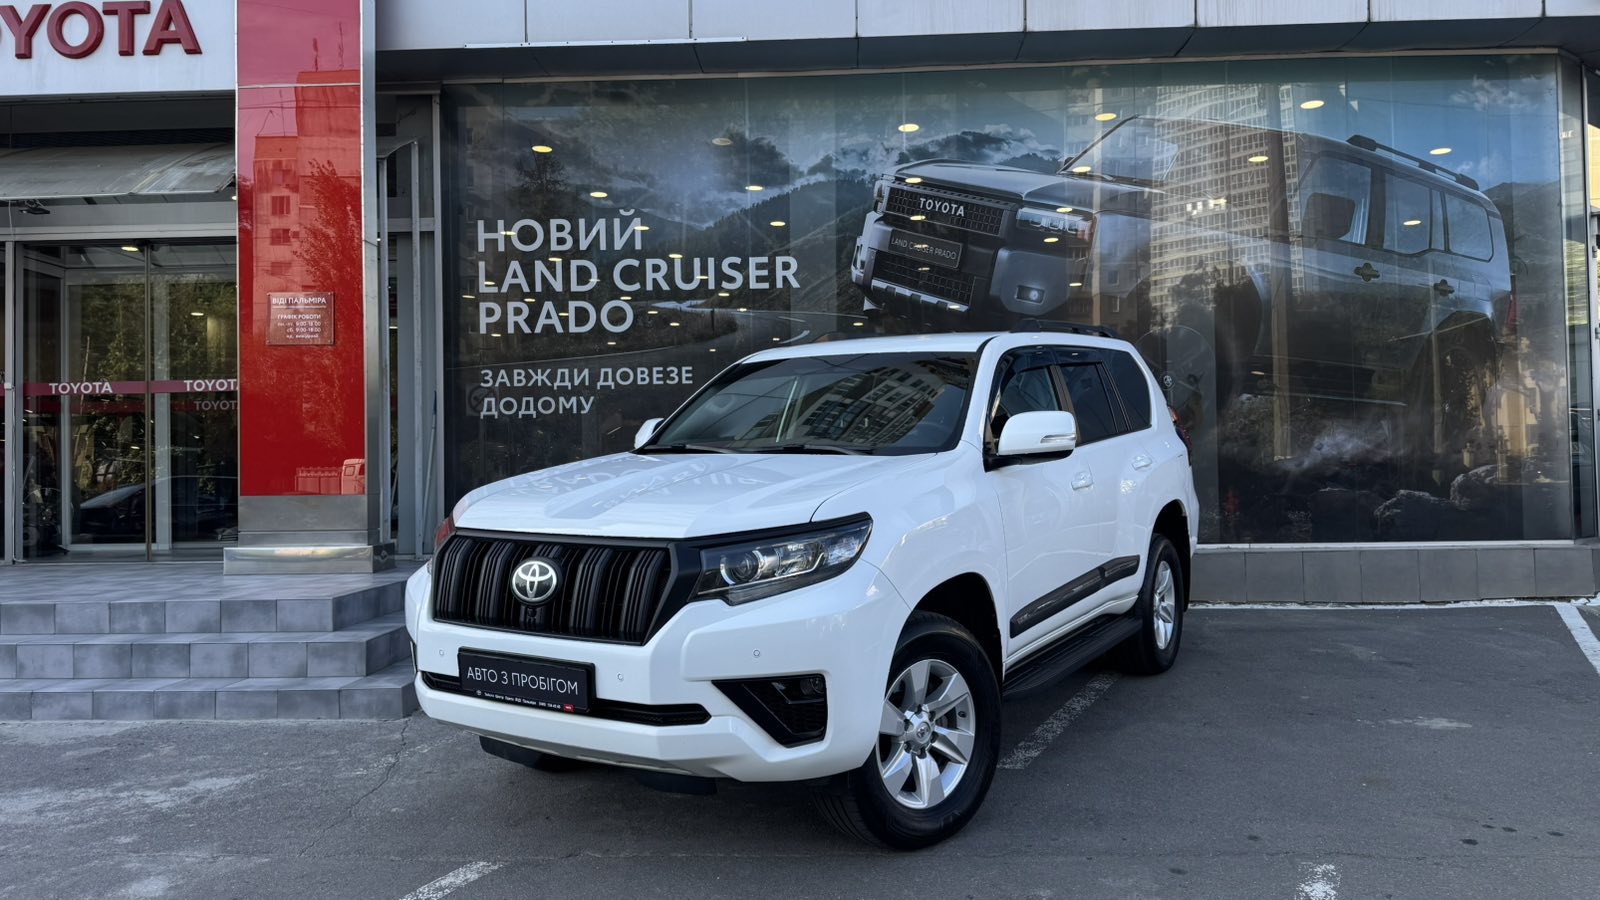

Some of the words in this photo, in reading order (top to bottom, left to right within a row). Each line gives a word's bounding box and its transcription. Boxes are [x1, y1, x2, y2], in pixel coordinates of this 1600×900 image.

[0, 0, 203, 59] YOTA
[919, 198, 965, 217] TOYOTA
[477, 209, 642, 253] НОВИЙ
[891, 238, 908, 248] LAND
[934, 247, 957, 260] PRADO
[478, 259, 597, 294] LAND
[612, 256, 802, 292] CRUISER
[272, 297, 287, 305] ВІДІ
[479, 299, 634, 334] PRADO
[48, 381, 113, 395] TOYOTA
[184, 379, 238, 391] TOYOT
[480, 367, 590, 390] ЗАВЖДИ
[597, 366, 693, 390] ДОВЕЗЕ
[194, 400, 238, 411] TOYOT
[480, 396, 595, 419] ДОДОМУ
[467, 666, 498, 683] АВТО
[501, 671, 509, 685] З
[511, 672, 578, 695] ПРОБІГОМ
